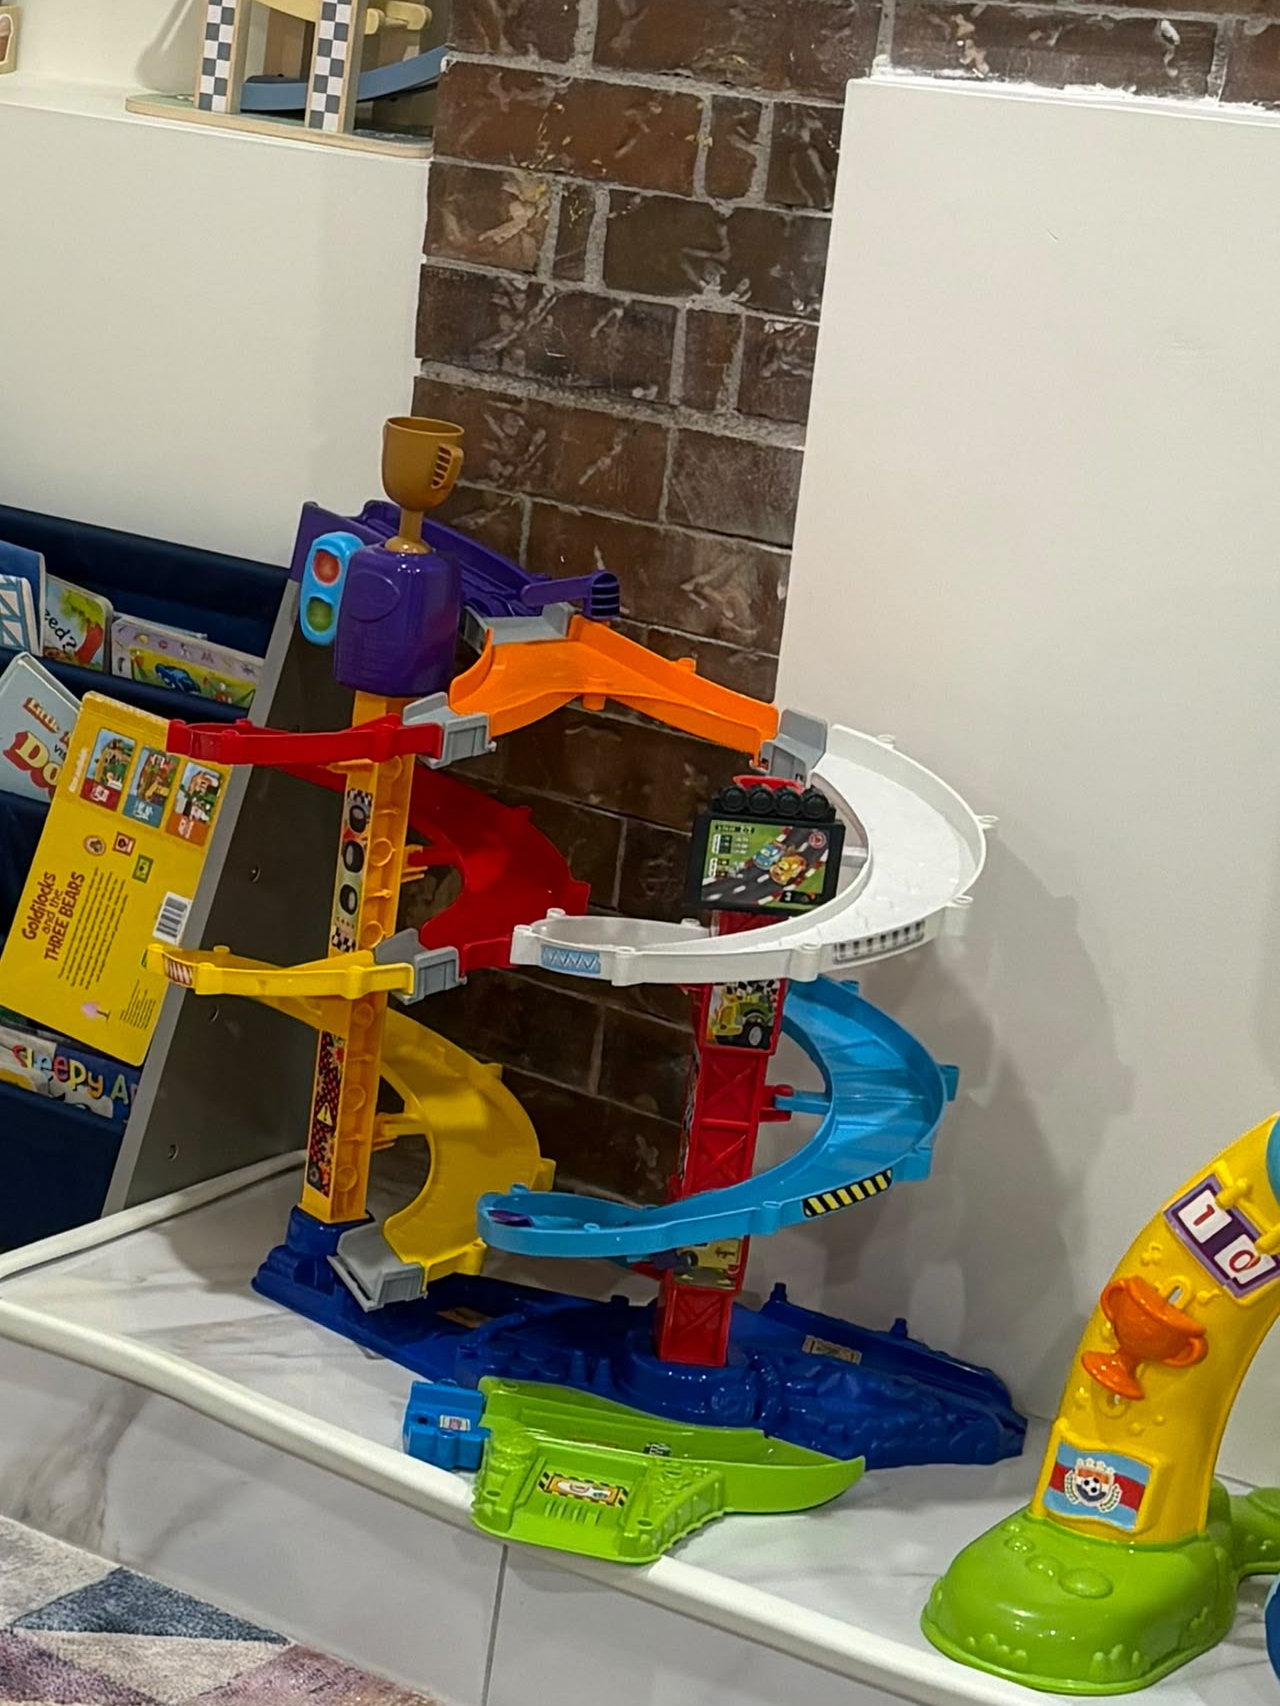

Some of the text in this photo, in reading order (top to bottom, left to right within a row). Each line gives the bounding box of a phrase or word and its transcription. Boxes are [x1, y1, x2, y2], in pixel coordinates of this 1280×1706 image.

[21, 871, 56, 941] Goldilocks
[42, 888, 63, 935] and the
[44, 871, 85, 961] THREE BEARS
[1193, 1203, 1216, 1227] 1
